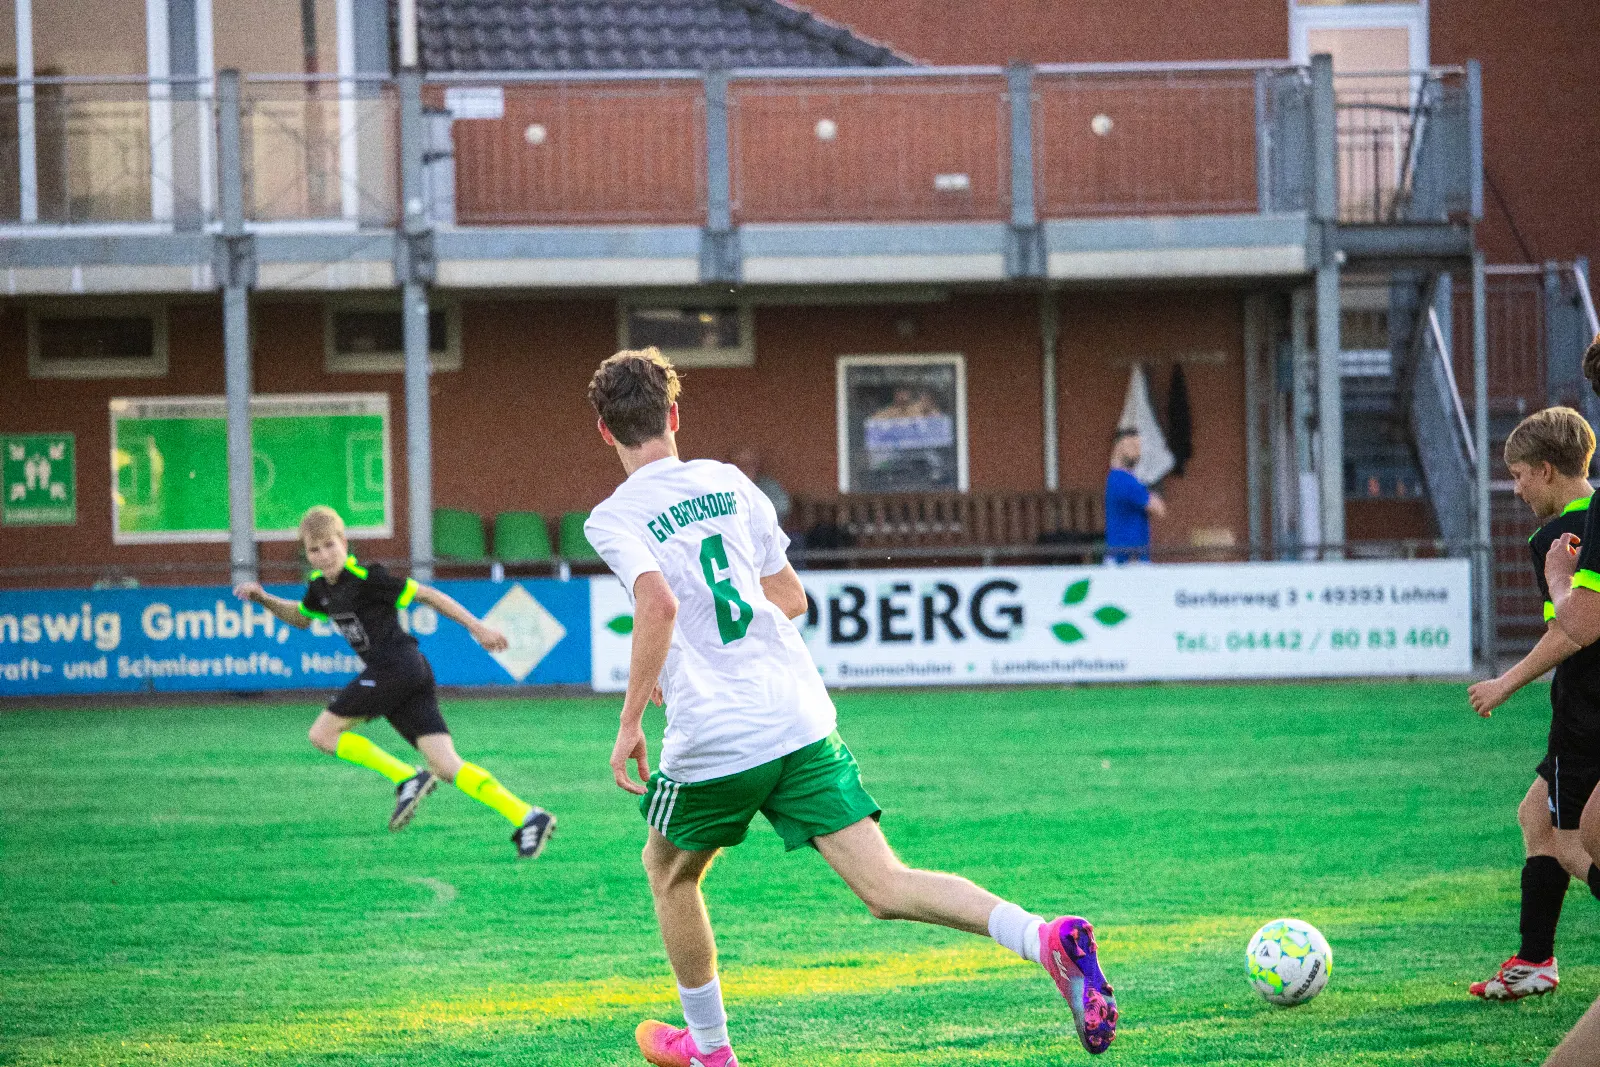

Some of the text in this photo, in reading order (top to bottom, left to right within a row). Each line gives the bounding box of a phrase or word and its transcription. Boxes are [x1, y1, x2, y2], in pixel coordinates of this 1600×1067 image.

[699, 533, 754, 646] 6
[141, 600, 290, 644] GmbH,
[1226, 630, 1302, 651] 04442
[1404, 627, 1450, 648] 460
[63, 655, 108, 680] und
[117, 651, 293, 678] Schmierstoffe,
